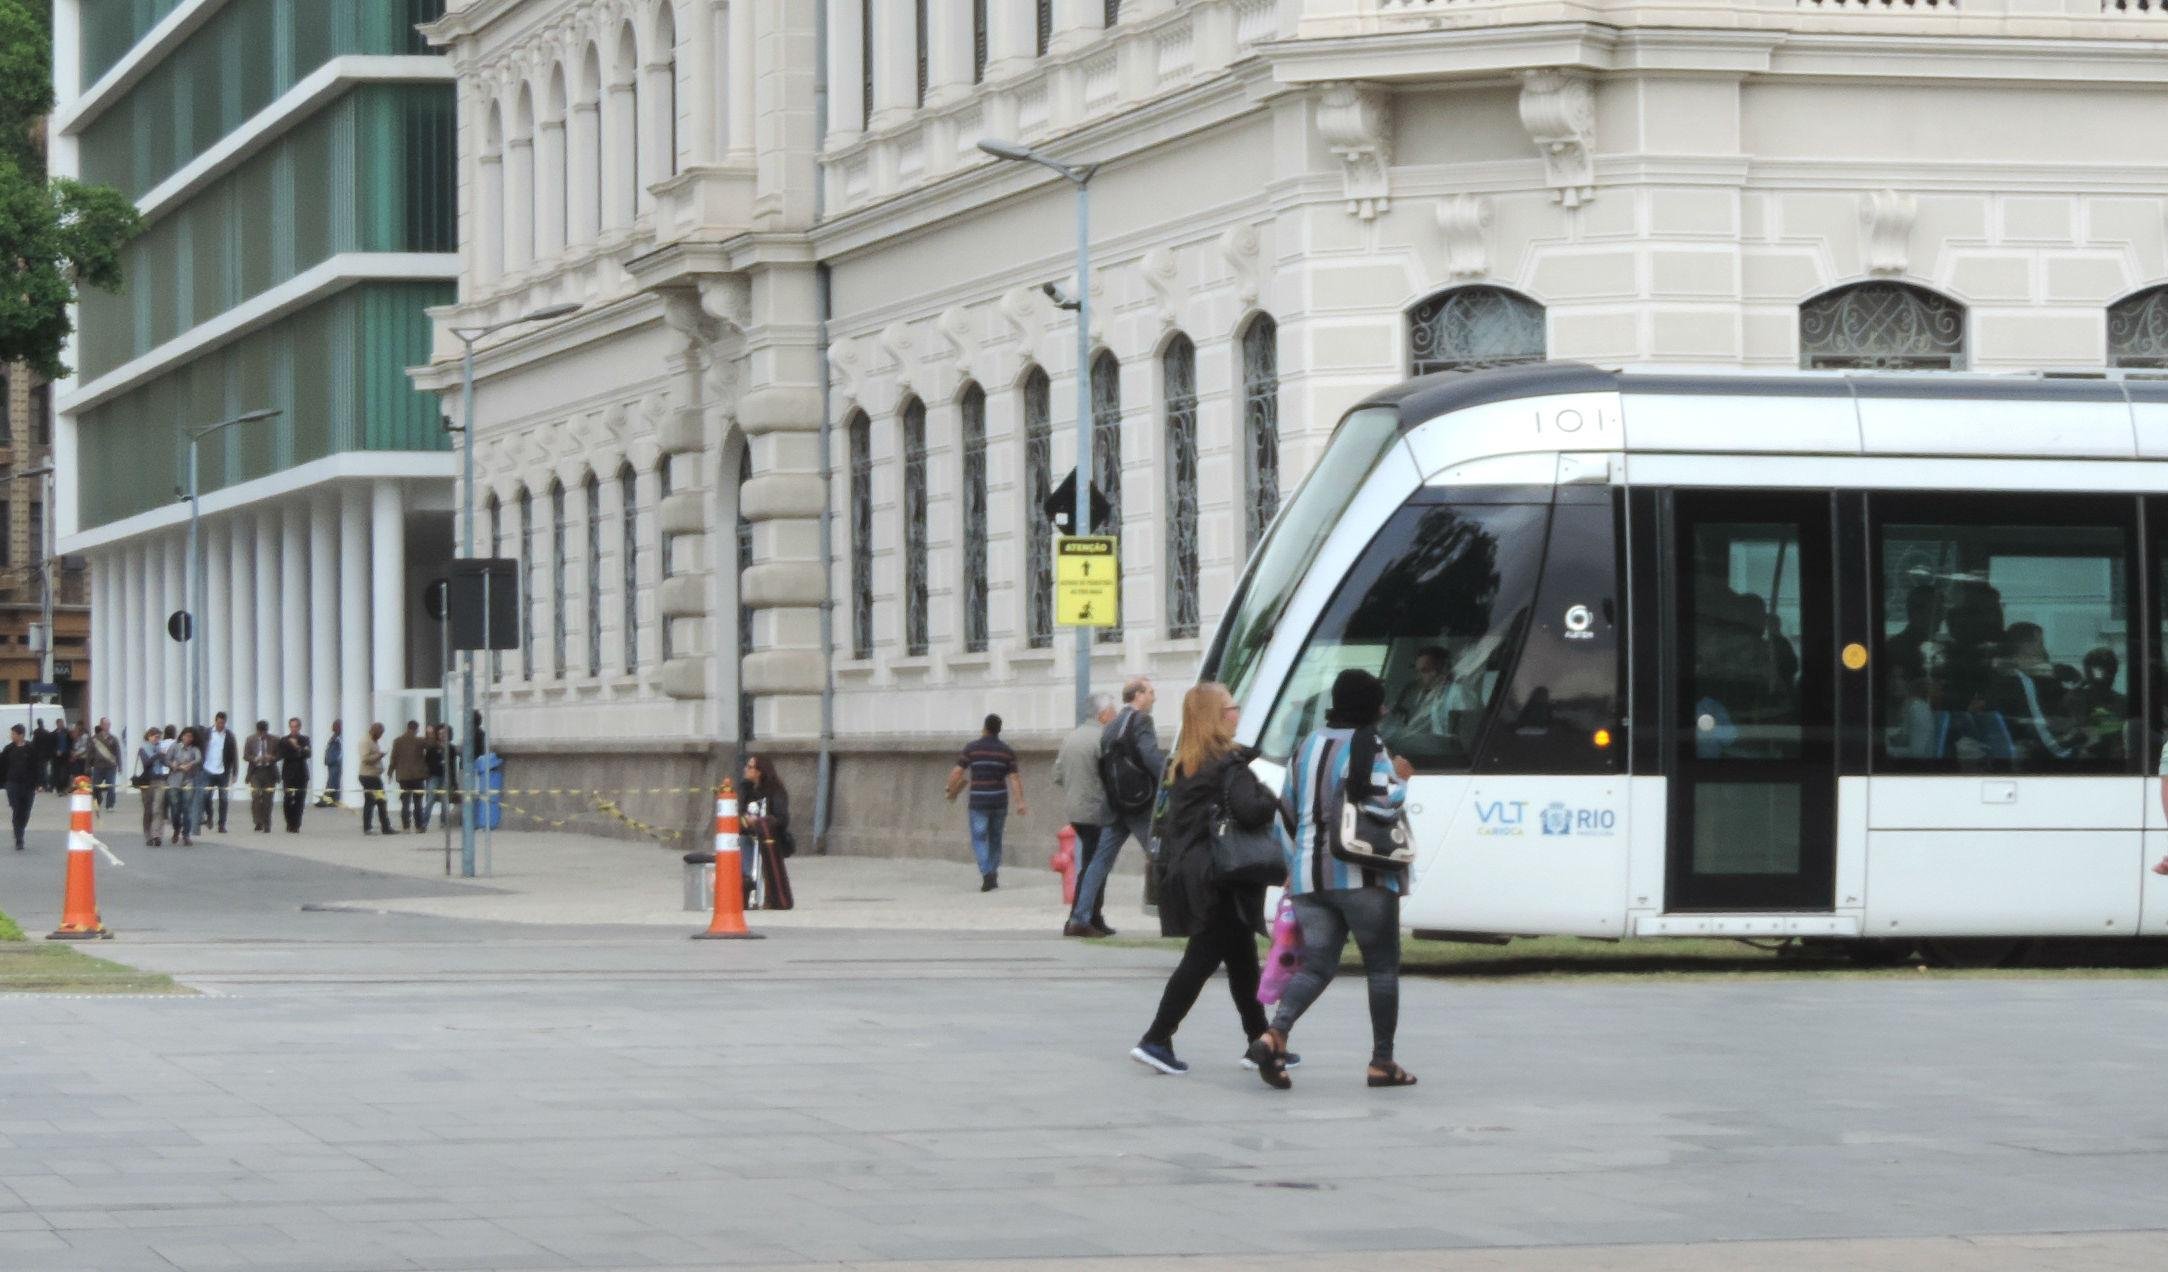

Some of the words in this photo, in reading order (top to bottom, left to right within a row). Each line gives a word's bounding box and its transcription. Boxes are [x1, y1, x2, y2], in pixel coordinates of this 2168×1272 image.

[1065, 542, 1108, 553] ATENÇÃO
[1475, 800, 1529, 823] VLT
[1576, 809, 1616, 829] RIO
